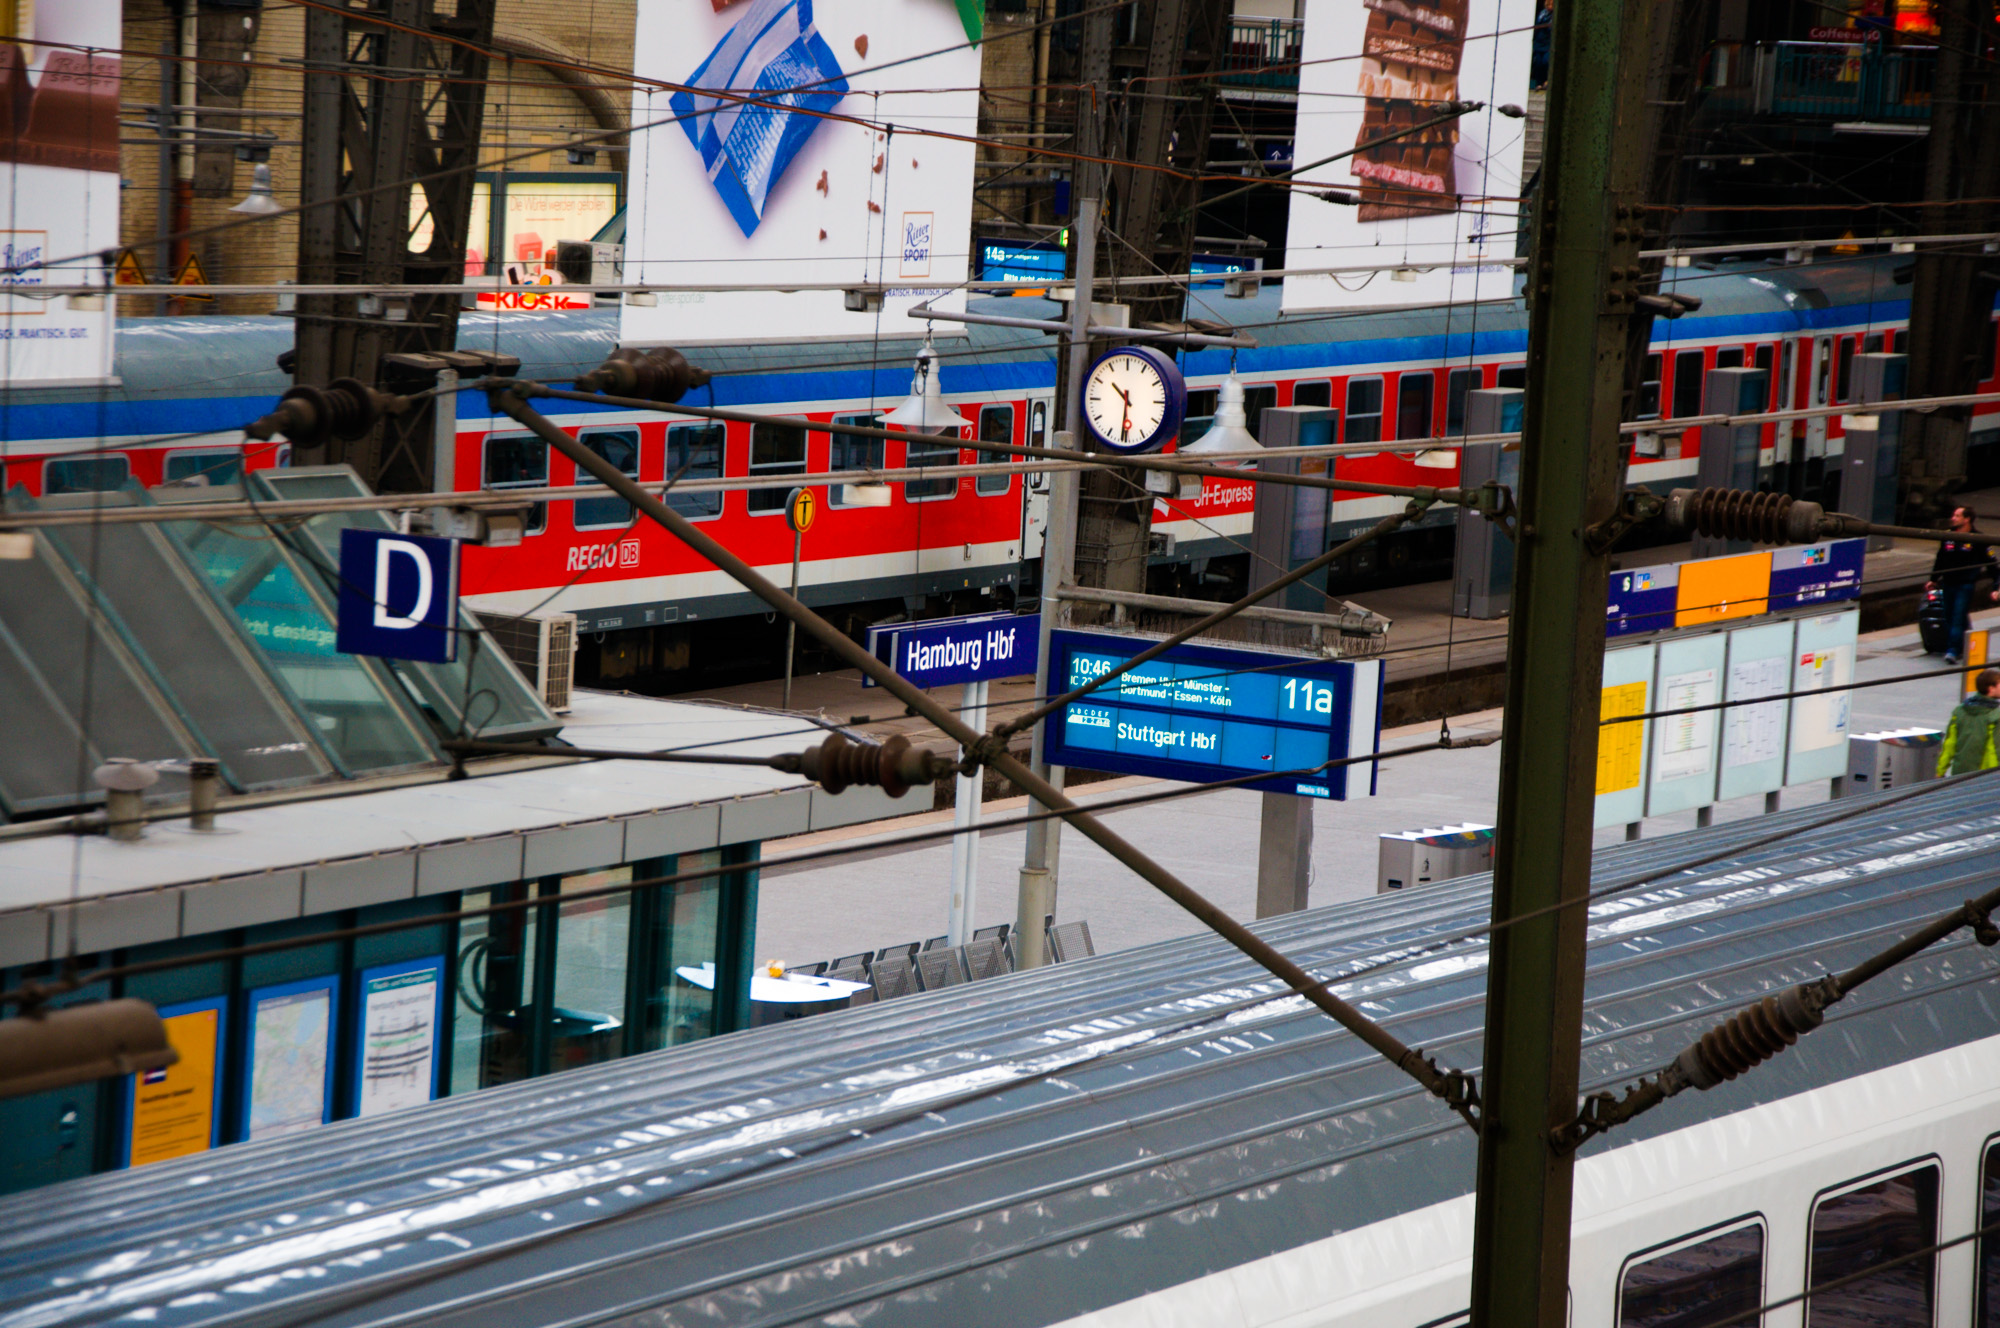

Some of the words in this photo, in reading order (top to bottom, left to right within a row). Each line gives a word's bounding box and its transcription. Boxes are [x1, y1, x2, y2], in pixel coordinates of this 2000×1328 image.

[1810, 27, 1850, 40] Coffee
[905, 222, 930, 248] Ritter
[903, 248, 929, 262] SPORT
[985, 246, 1005, 262] 14a
[495, 291, 571, 311] KIOSK
[566, 543, 618, 572] REGIO
[621, 540, 639, 565] DB
[373, 537, 433, 630] D
[272, 622, 337, 647] einsteige
[907, 636, 982, 672] Hamburg
[986, 627, 1016, 661] Hbf
[1072, 657, 1111, 677] 10:46
[1070, 675, 1079, 686] IC
[1121, 671, 1157, 684] Bremen
[1183, 679, 1222, 693] Münster
[1120, 683, 1167, 699] Dortmund
[1174, 690, 1203, 703] Essen
[1210, 694, 1232, 707] Köln
[1283, 678, 1333, 714] 11a
[1117, 722, 1186, 748] Stuttgart
[1190, 731, 1217, 750] Hbf
[1297, 784, 1316, 794] Gleis
[1316, 787, 1329, 796] 11a
